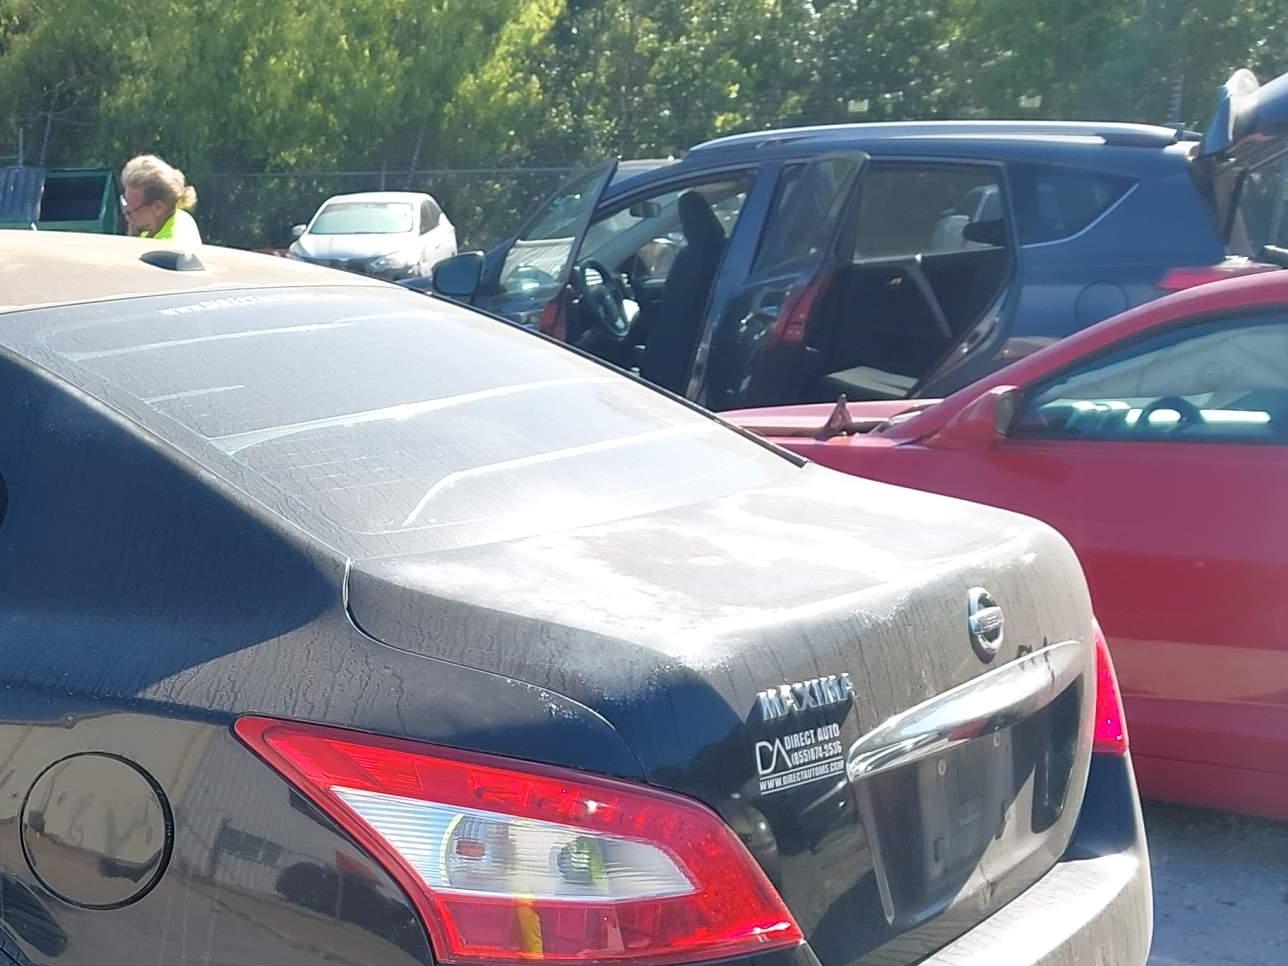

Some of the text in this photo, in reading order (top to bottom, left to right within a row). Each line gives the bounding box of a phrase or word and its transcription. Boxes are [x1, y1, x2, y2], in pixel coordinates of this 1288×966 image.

[756, 672, 855, 721] MAXIMA
[783, 723, 840, 751] DIRECT AUTO
